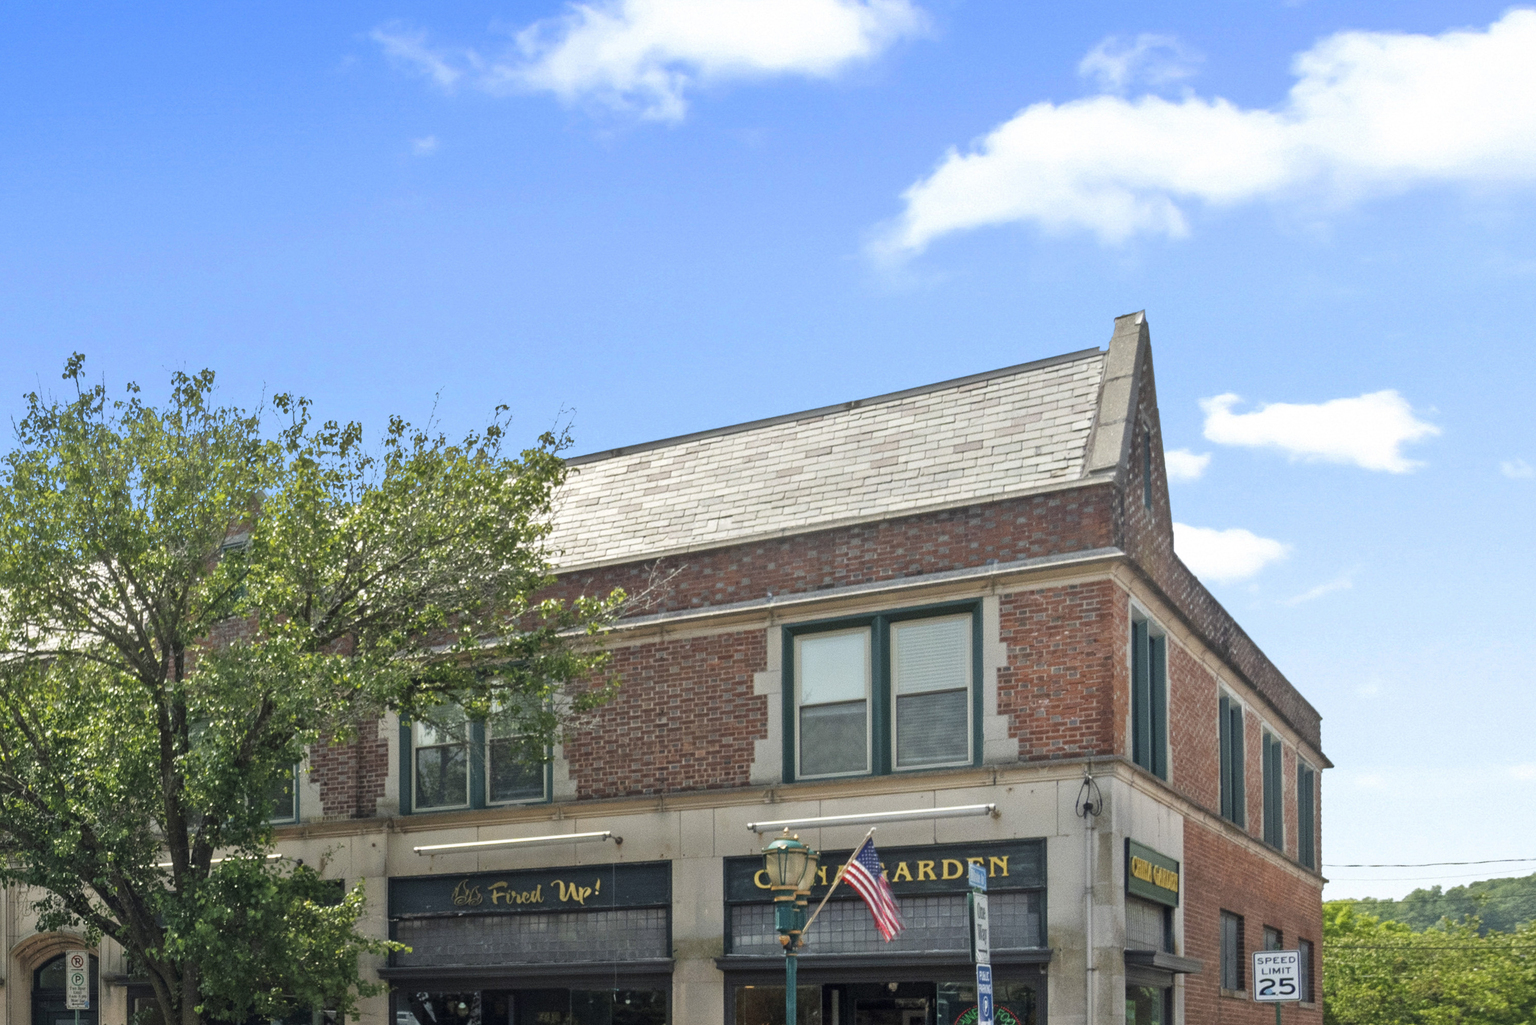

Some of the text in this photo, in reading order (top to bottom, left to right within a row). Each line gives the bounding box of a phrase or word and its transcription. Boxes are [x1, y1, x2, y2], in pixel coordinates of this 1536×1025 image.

[878, 855, 1010, 885] ARDN
[487, 877, 601, 905] Fired Up!
[1257, 956, 1296, 965] SPEED
[1261, 967, 1291, 975] LIMIT
[1259, 977, 1296, 996] 25
